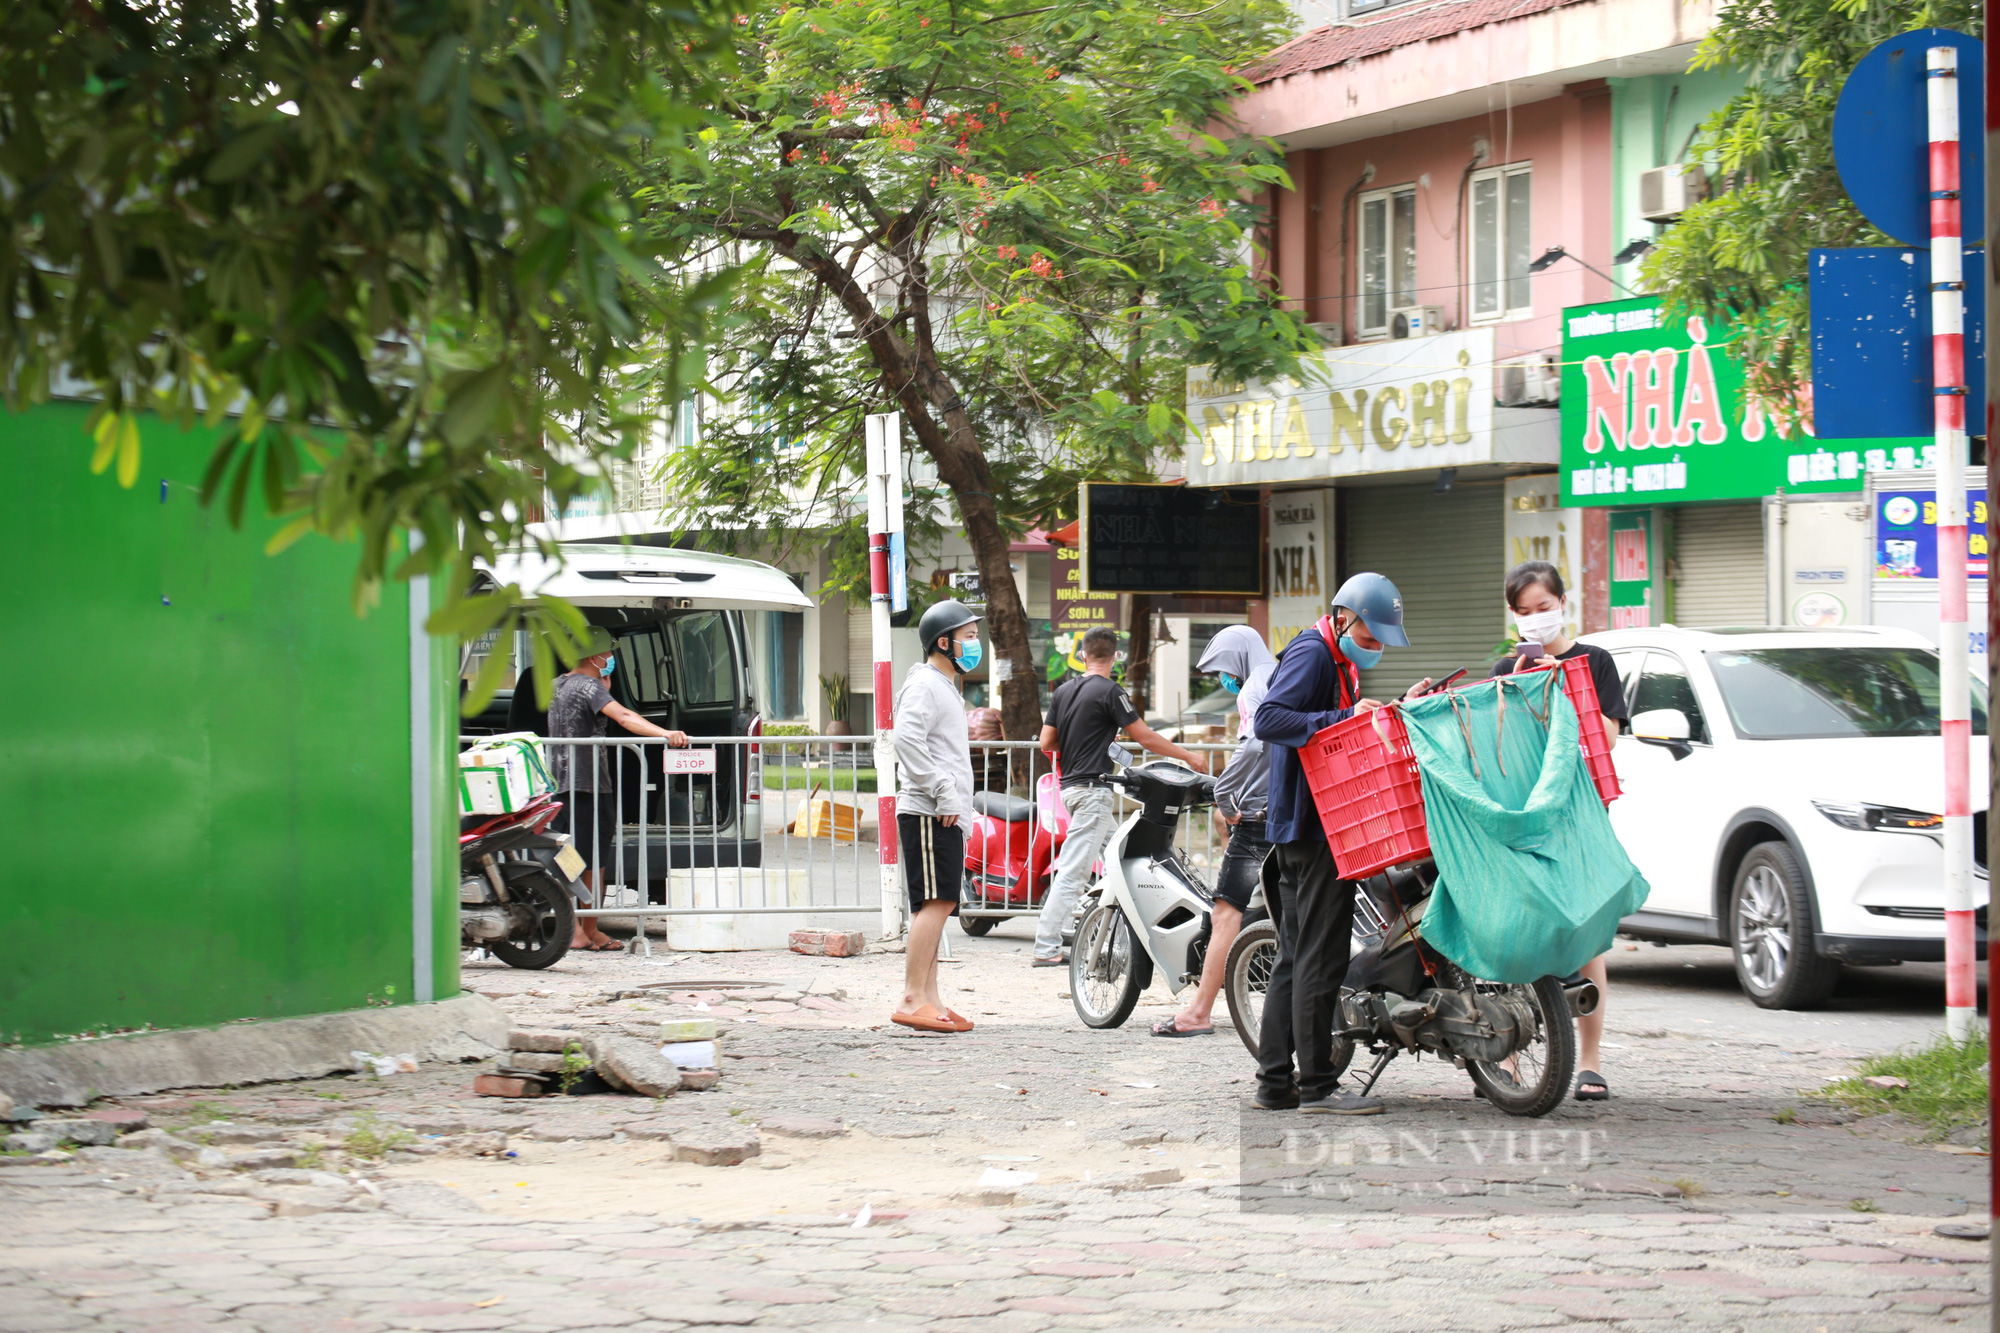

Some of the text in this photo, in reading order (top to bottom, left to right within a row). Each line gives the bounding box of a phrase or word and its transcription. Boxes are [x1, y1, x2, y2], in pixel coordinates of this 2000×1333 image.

[1201, 349, 1472, 467] NHÀ NGHỈ
[1583, 316, 1727, 453] NHÀ
[1273, 531, 1320, 598] NHÀ
[1092, 608, 1105, 620] LA
[675, 760, 706, 769] STOP
